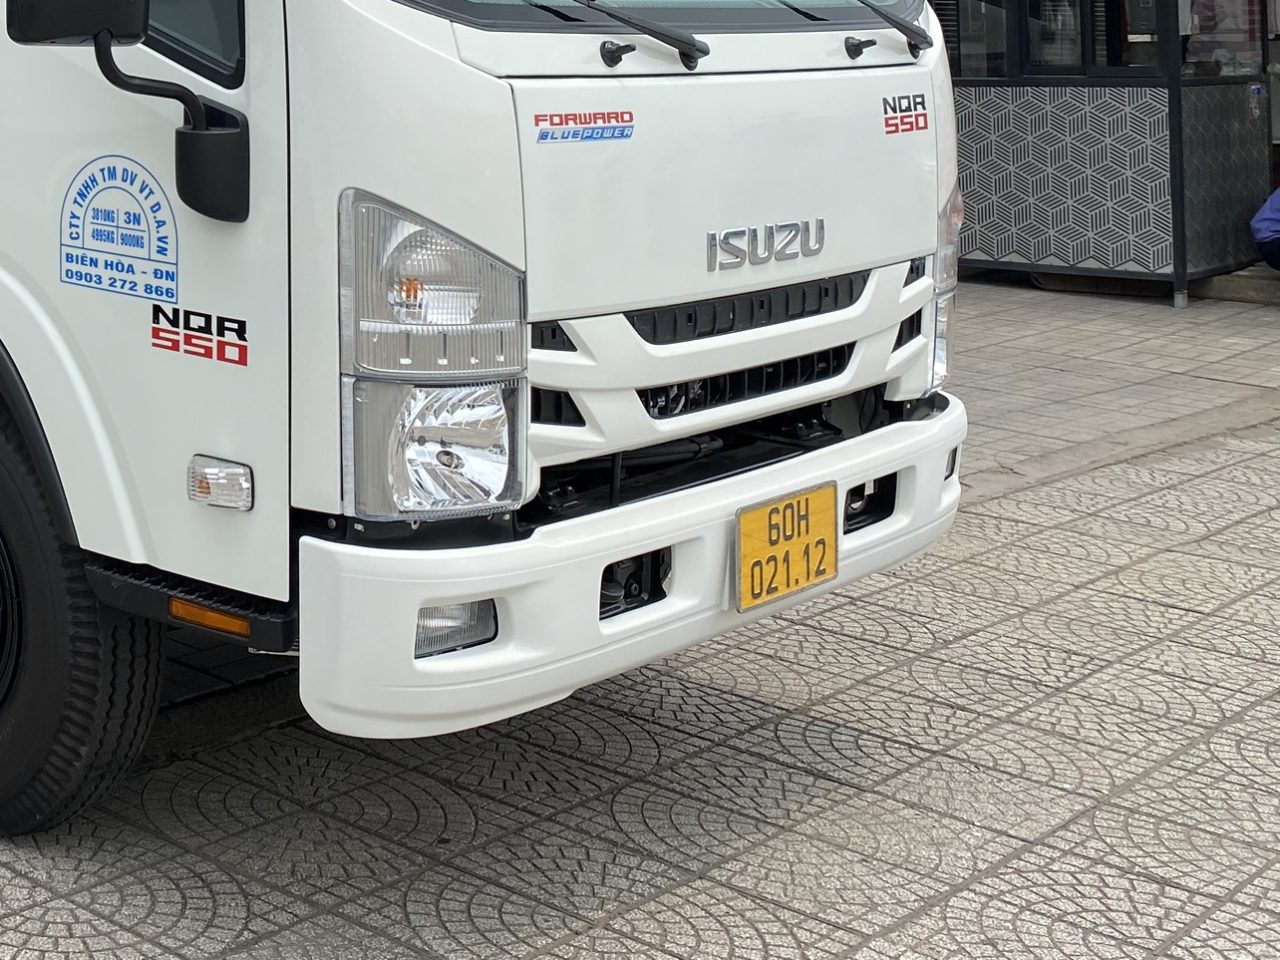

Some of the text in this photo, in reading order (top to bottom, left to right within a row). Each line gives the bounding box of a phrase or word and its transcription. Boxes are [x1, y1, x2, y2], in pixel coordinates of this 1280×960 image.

[533, 111, 634, 127] FORWARD
[882, 93, 927, 116] NQR
[884, 112, 928, 135] 550
[99, 166, 117, 183] TM
[121, 167, 138, 186] DV
[73, 173, 99, 208] TNHH
[138, 180, 155, 201] VT
[69, 211, 81, 241] CTY
[91, 207, 141, 226] 3810KG 3N
[120, 232, 145, 249] 9000KG
[707, 217, 824, 273] ISUZU
[65, 252, 99, 269] BIÊN
[104, 258, 136, 276] HÒA
[152, 268, 176, 282] ĐN
[65, 269, 176, 300] 0903 272 866
[151, 303, 249, 343] NQR
[151, 325, 249, 367] 550
[768, 497, 810, 546] 60H
[751, 538, 827, 600] 021.12
